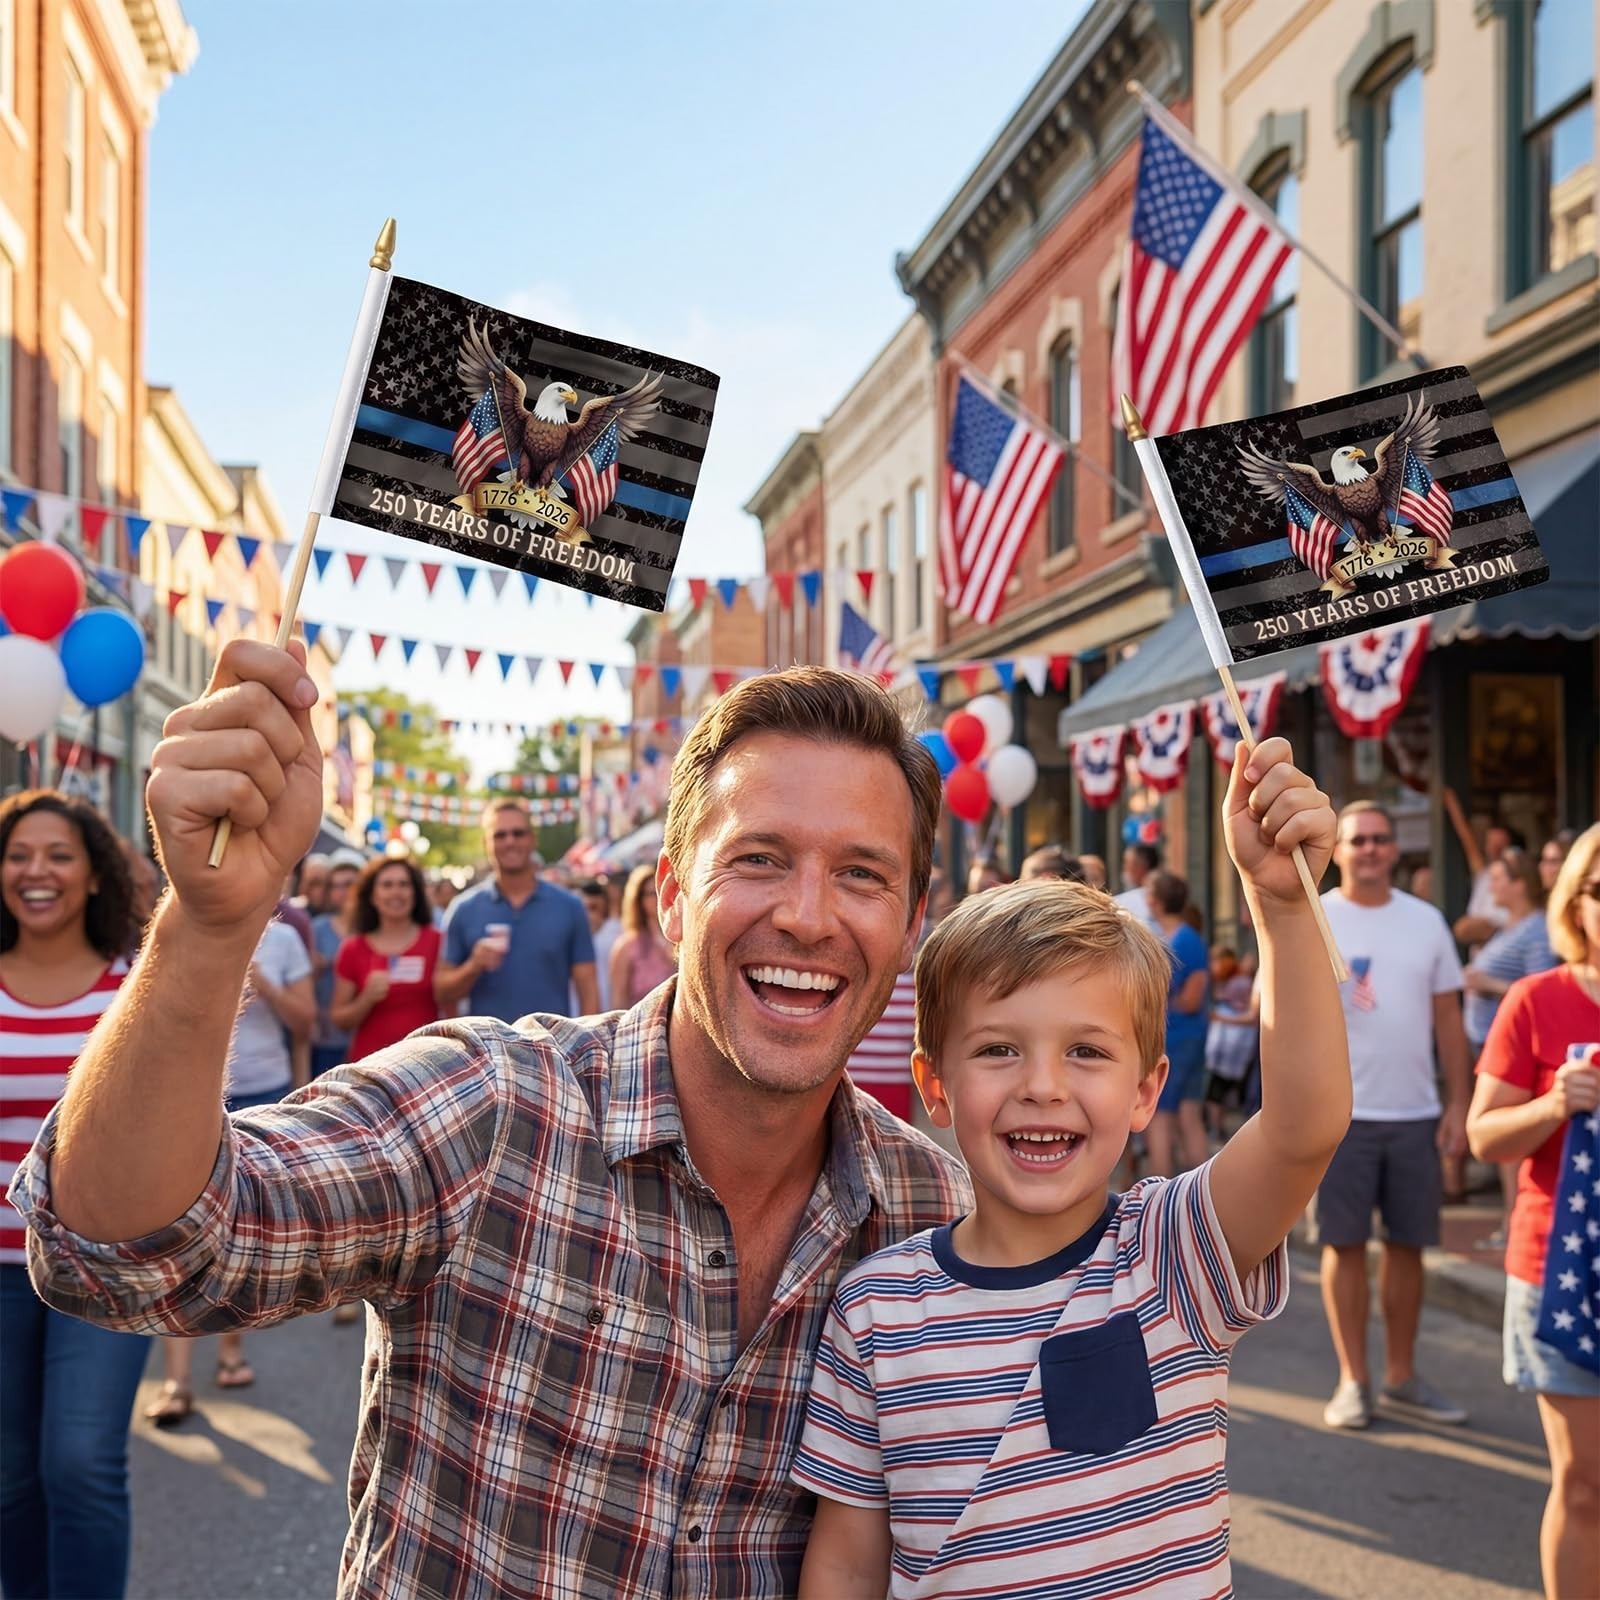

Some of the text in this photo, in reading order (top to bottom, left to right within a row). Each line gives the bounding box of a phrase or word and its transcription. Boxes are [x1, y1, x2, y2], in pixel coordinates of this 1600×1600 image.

[369, 487, 636, 583] 250 YEARS OF FREEDOM
[482, 489, 570, 525] 1776 2026
[1340, 541, 1428, 577] 1776 2026
[1253, 554, 1520, 641] 250 YEARS OF FREEDOM
